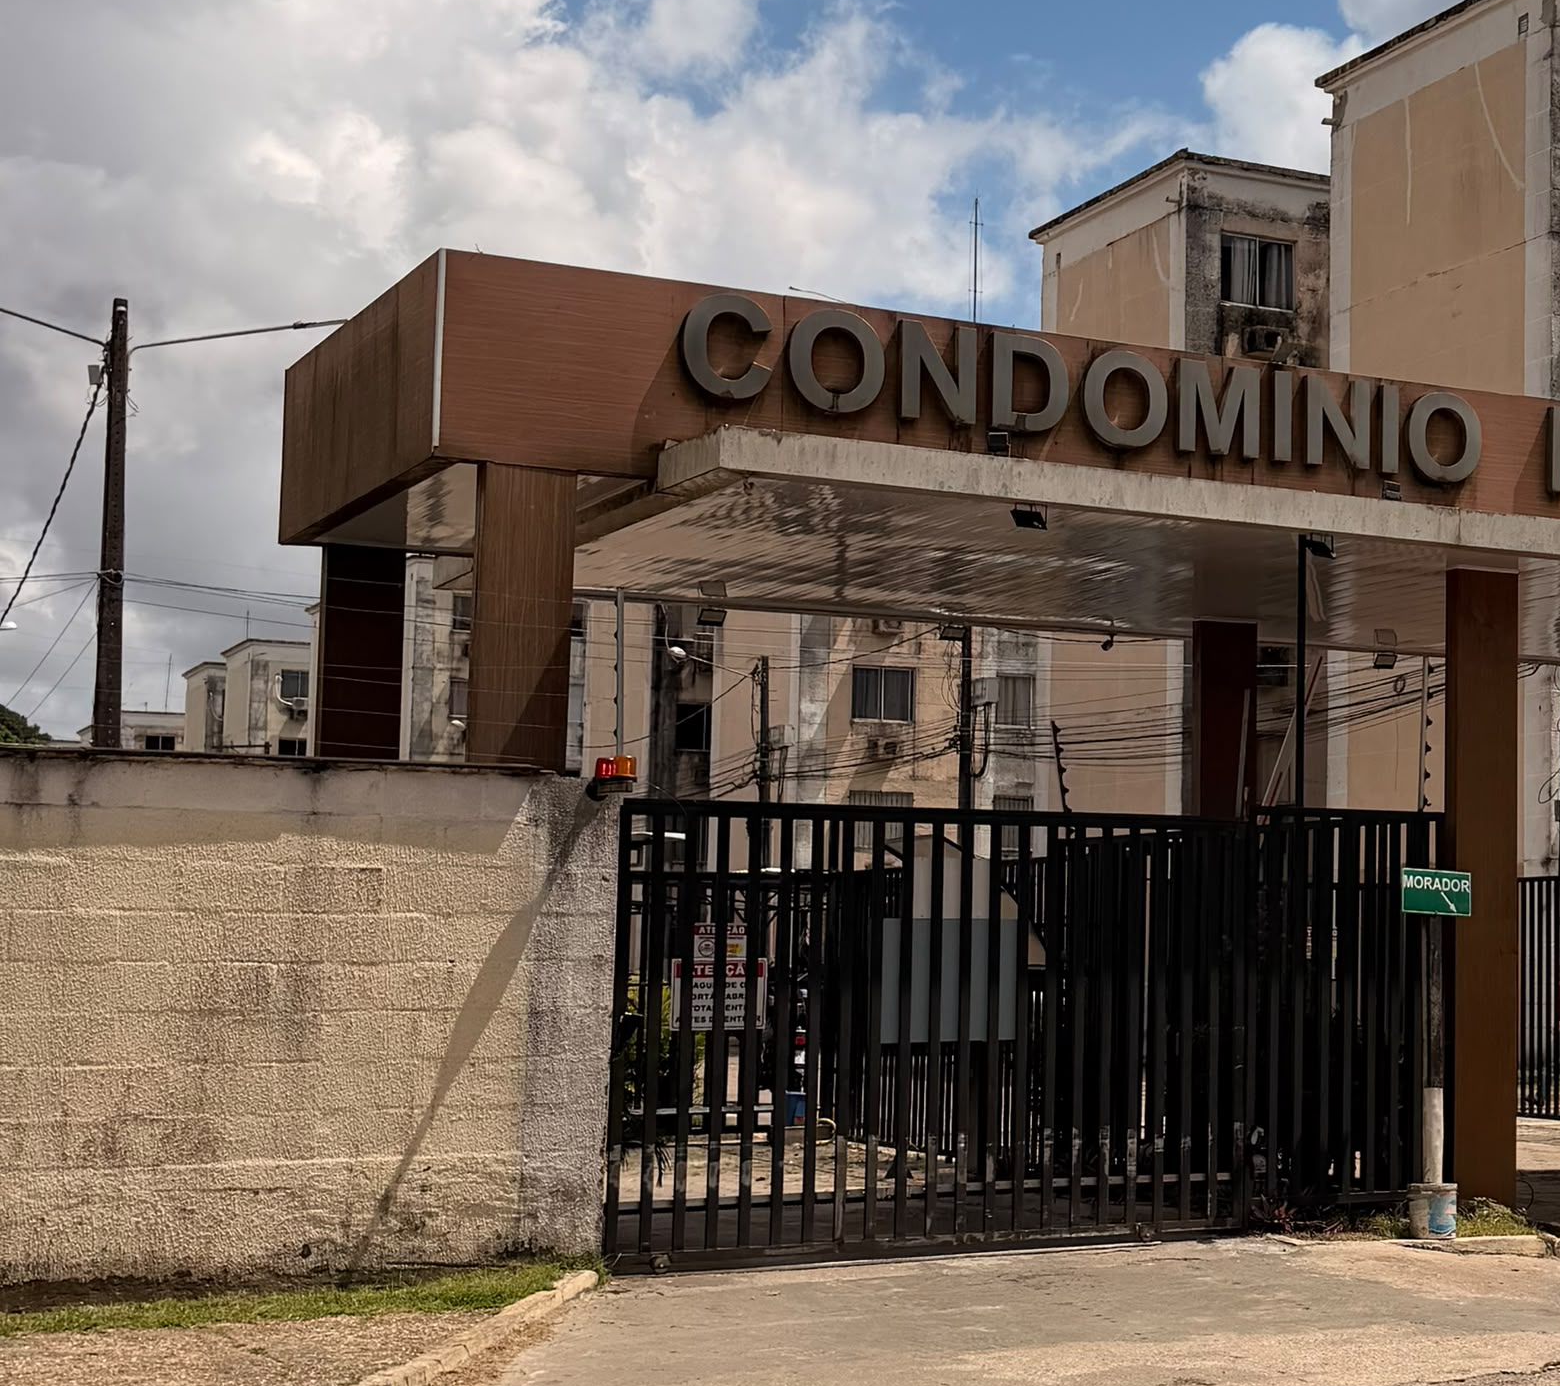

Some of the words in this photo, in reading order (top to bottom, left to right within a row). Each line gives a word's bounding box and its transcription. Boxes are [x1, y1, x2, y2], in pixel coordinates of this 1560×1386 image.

[682, 293, 1483, 484] CONDOMINIO
[1403, 875, 1470, 893] MORADOR
[699, 925, 745, 934] ATEÇÃO
[684, 961, 757, 977] TEÇÃ
